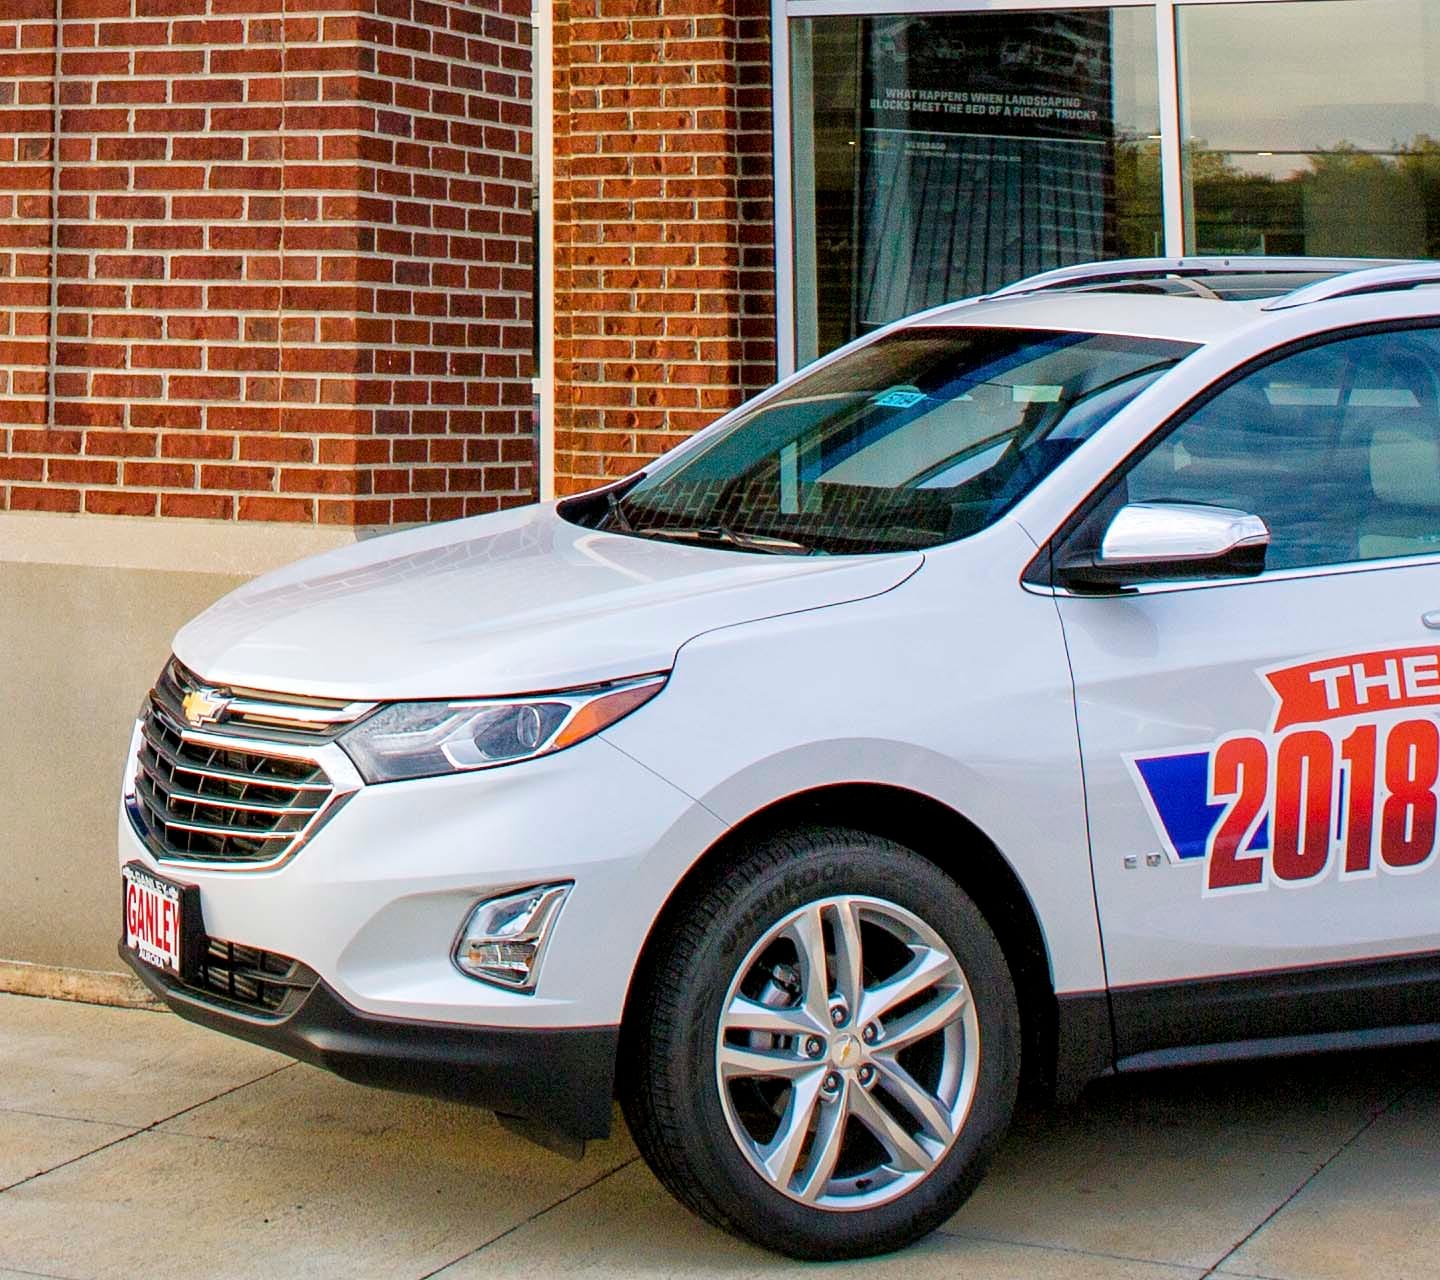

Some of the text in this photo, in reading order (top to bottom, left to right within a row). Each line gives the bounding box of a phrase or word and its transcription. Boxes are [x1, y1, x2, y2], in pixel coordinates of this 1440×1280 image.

[870, 98, 1098, 121] BLOCKS MEET THE BED OF A PICKUP TRUCK?
[886, 88, 1080, 108] WHAT HAPPENS WHEN LANDSCAPING
[134, 871, 167, 895] GANLEY
[127, 883, 180, 957] GANLEY
